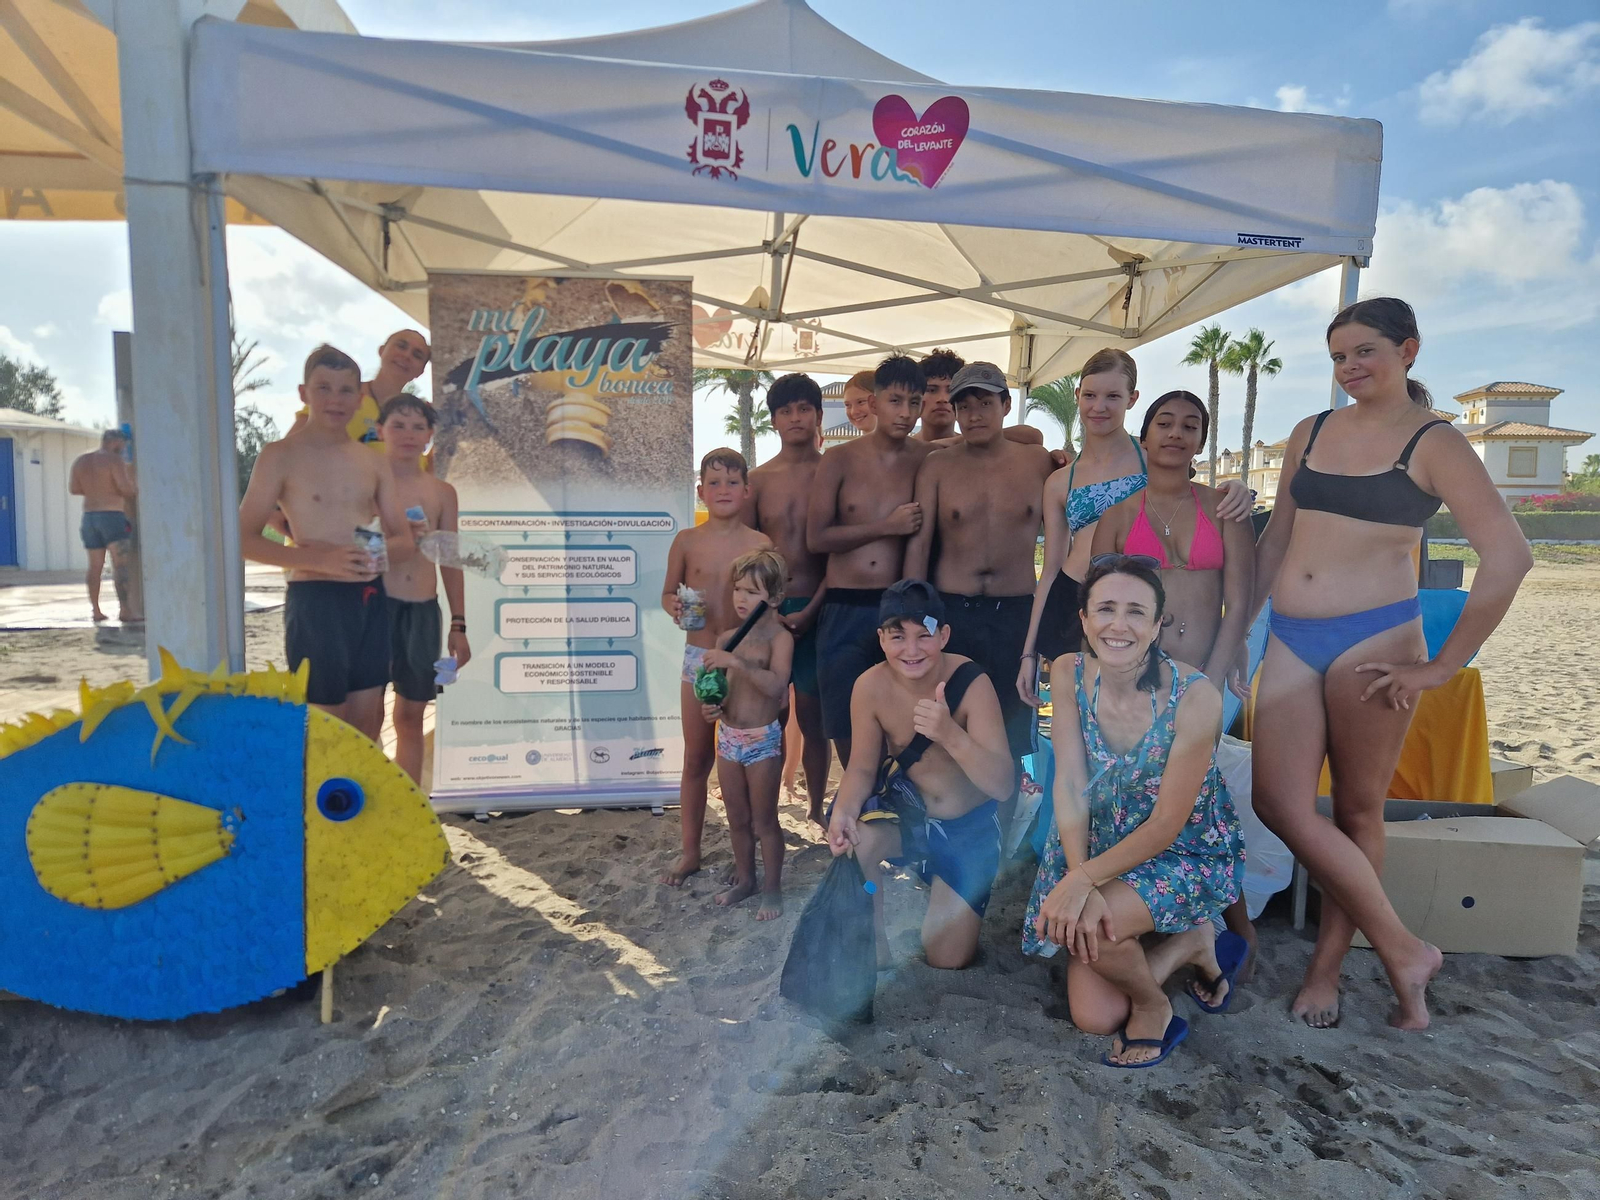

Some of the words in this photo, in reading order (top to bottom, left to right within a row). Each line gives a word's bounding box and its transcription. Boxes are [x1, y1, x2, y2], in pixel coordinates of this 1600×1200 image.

[901, 121, 946, 138] CORAZÓN
[786, 119, 902, 182] Vera
[897, 139, 914, 150] DEL
[914, 138, 954, 152] LEVANTE
[1237, 236, 1302, 248] MASTERTENT
[467, 300, 523, 332] mi
[463, 305, 655, 391] playa
[597, 371, 674, 395] bonica
[460, 518, 547, 527] DESCONTAMINACIÓN
[551, 518, 613, 527] INVESTIGACIÓN
[617, 518, 671, 527] DIVULGACIÓN
[505, 616, 553, 624] PROTECCIÓN
[600, 615, 631, 623] PÚBLICA
[524, 670, 569, 678] ECONÓMICO
